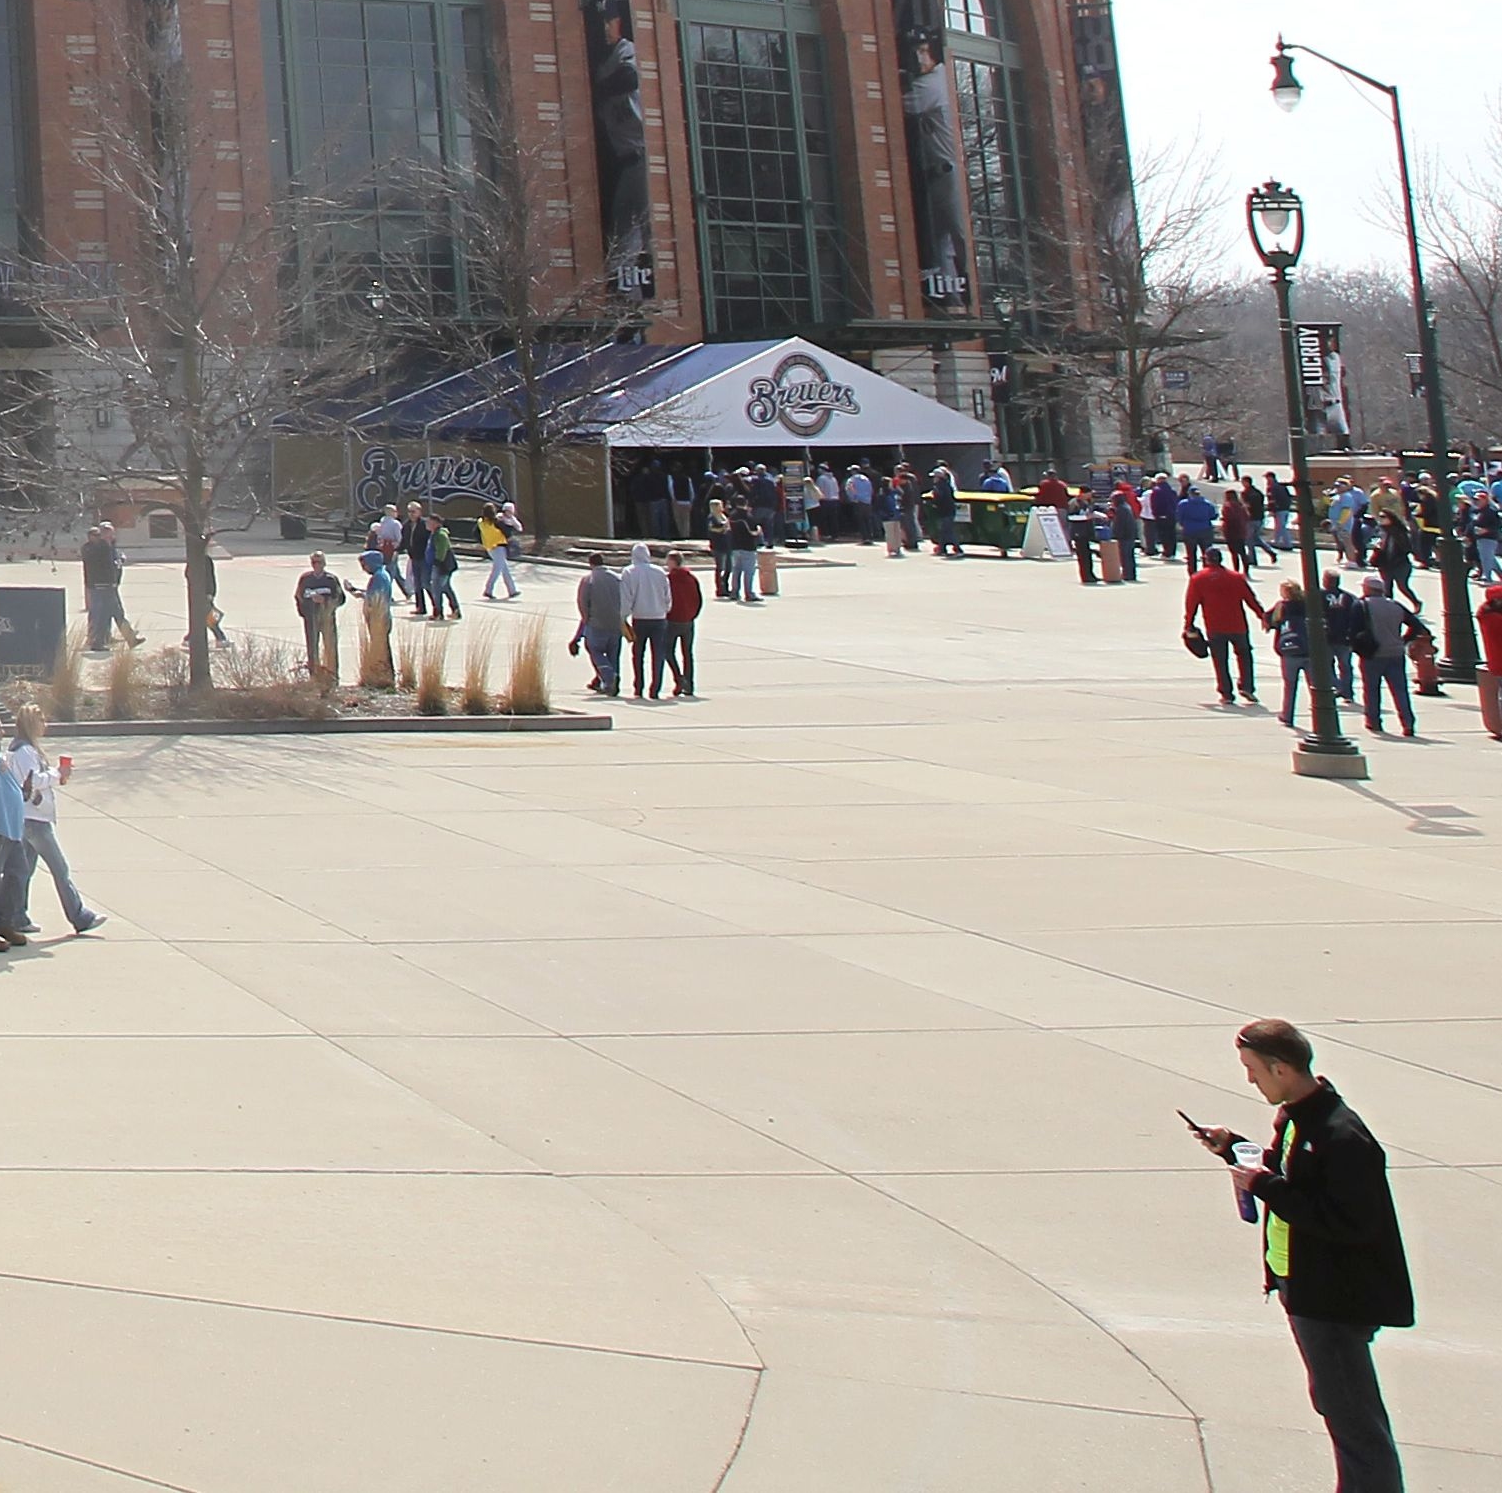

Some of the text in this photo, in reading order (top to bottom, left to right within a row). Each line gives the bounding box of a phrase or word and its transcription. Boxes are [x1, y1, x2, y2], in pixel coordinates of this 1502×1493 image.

[929, 273, 967, 298] Lite
[1299, 327, 1324, 385] LUCROY
[745, 378, 858, 425] Brewers
[356, 445, 510, 512] Brewers
